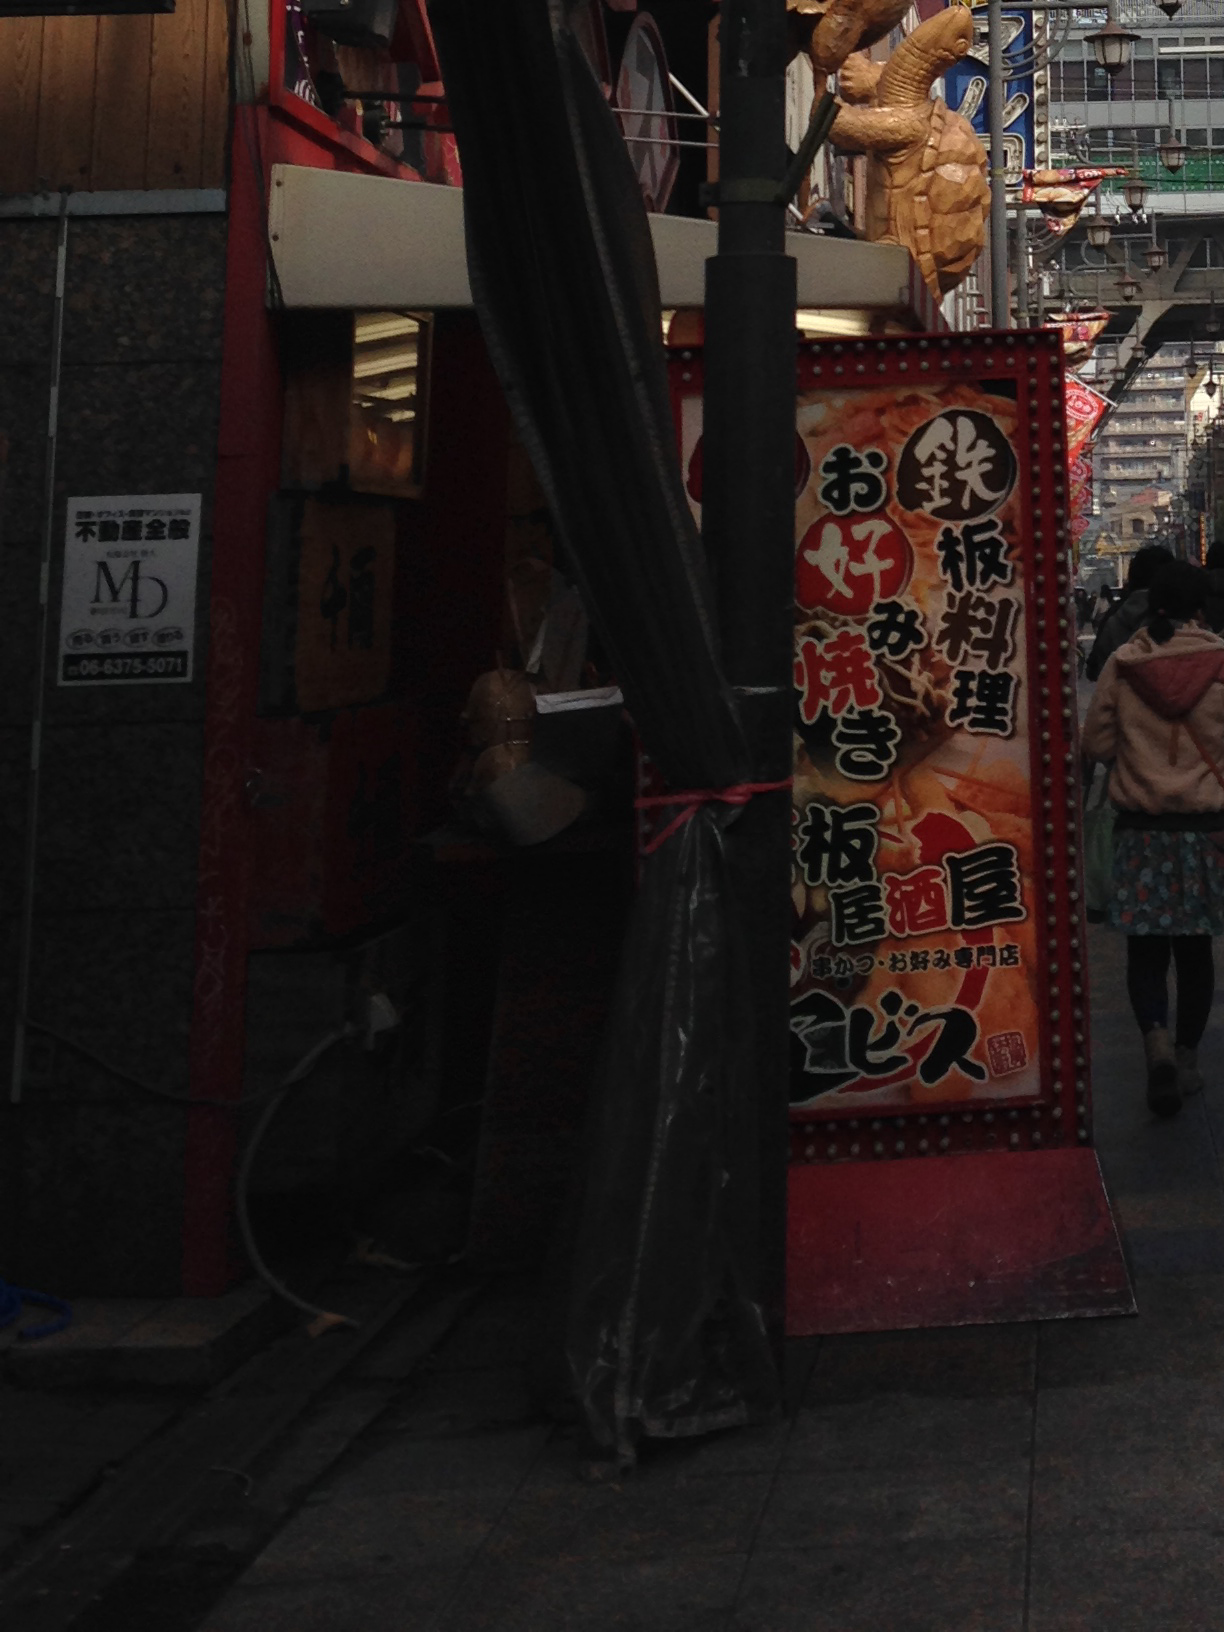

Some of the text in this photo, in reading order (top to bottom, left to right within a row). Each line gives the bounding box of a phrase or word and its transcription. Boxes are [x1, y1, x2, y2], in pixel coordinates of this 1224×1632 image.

[799, 445, 927, 780] お好み焼き
[911, 412, 1021, 736] 鉄板料理
[791, 803, 1026, 947] 板居酒屋
